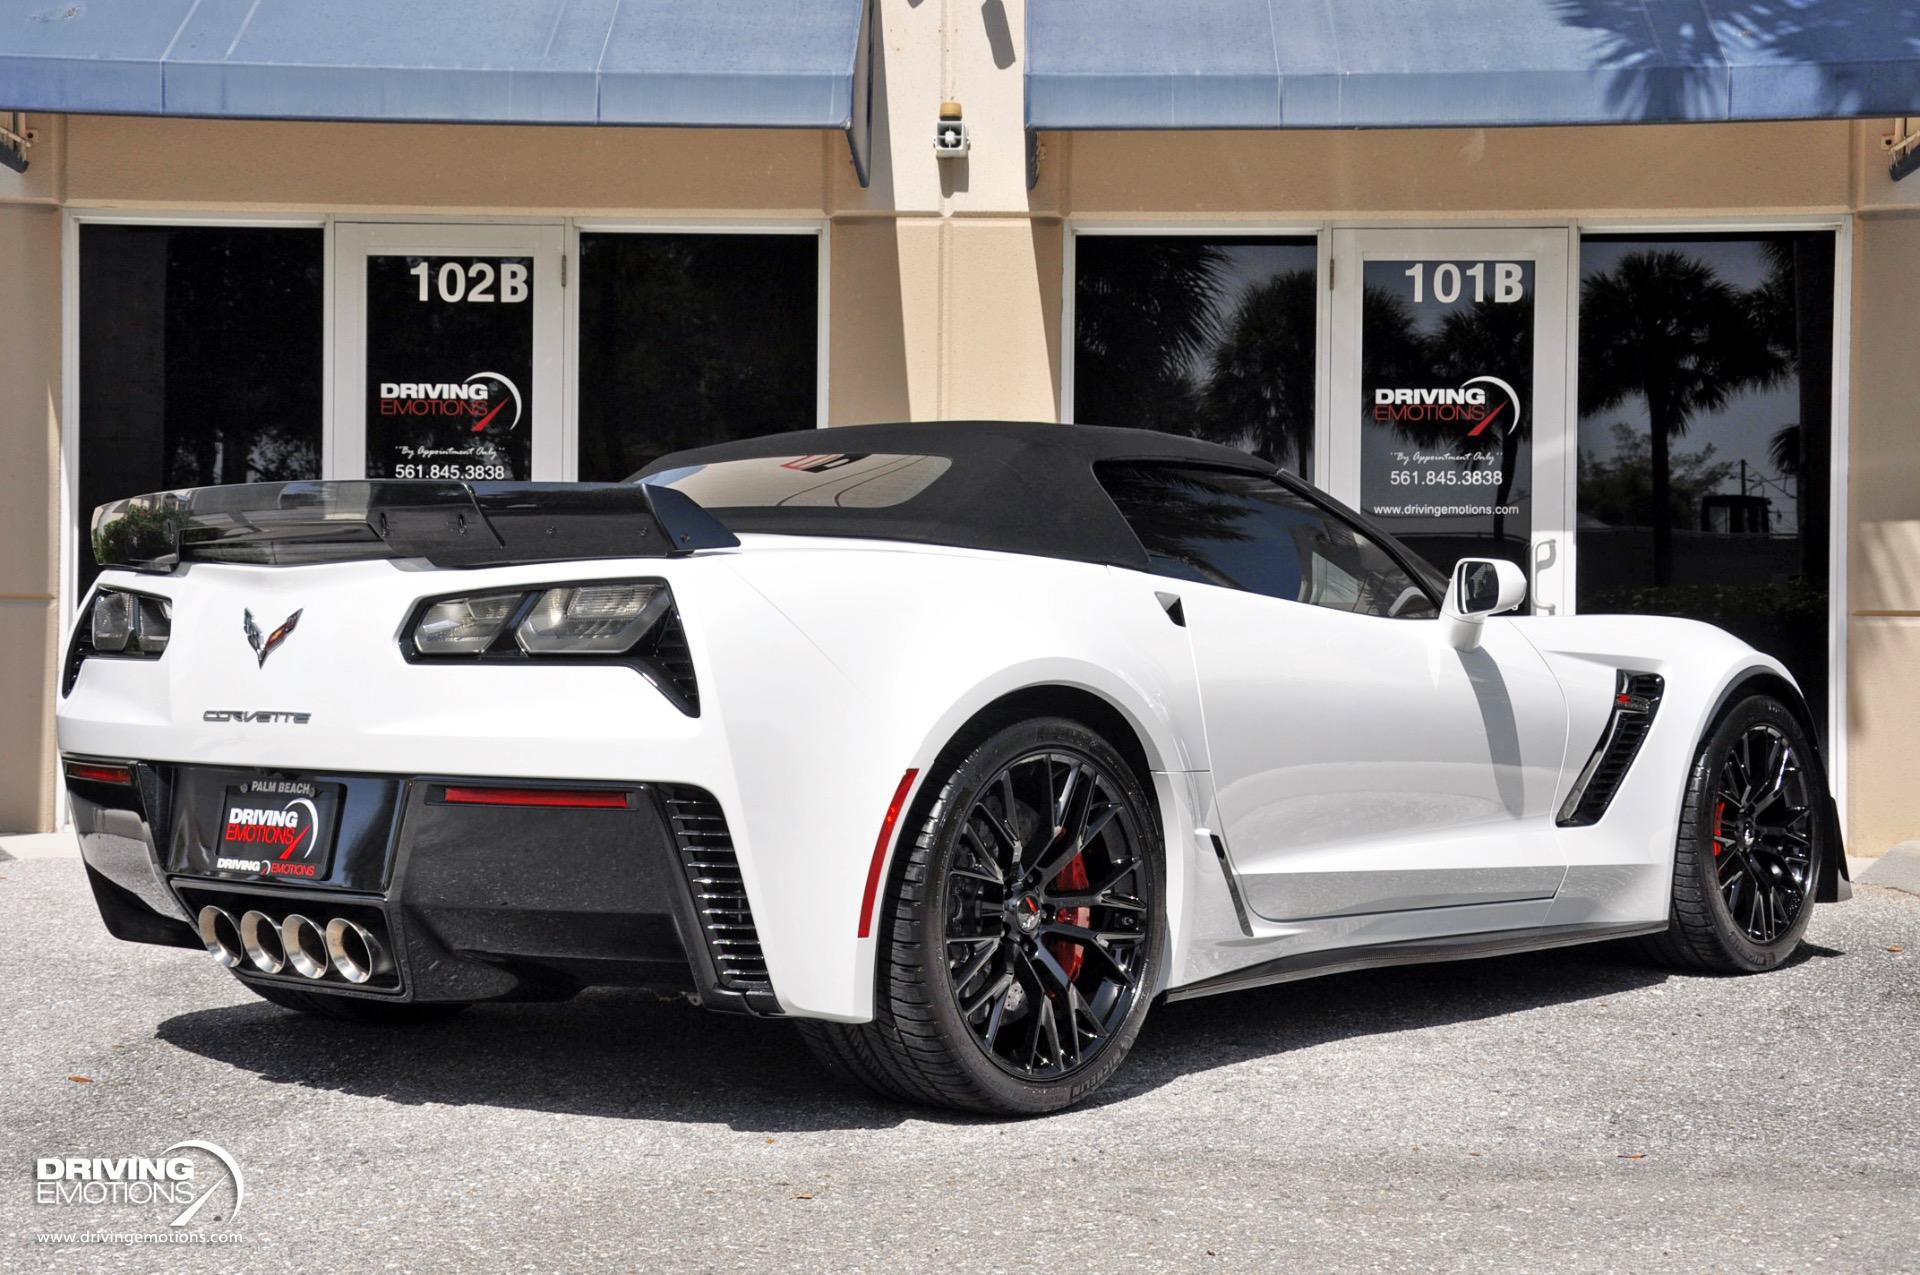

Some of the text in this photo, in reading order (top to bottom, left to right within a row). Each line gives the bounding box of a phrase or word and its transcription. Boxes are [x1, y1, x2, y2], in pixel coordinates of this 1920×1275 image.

[410, 262, 528, 303] 102B
[1405, 262, 1524, 303] 101B
[380, 383, 488, 400] DRIVING
[1375, 388, 1486, 405] DRIVING
[380, 400, 488, 416] EMOTIONS
[1375, 405, 1485, 421] EMOTIONS
[416, 446, 474, 458] Appointment
[1413, 453, 1470, 464] Appointment
[395, 464, 505, 480] 561.845.3838
[1390, 470, 1503, 485] 561.845.3838
[1374, 504, 1519, 517] www.drivingemotions.com
[203, 710, 312, 724] CORVETTE
[251, 780, 310, 795] PALM BEACH
[229, 808, 298, 828] DRIVING
[225, 823, 295, 844] EMOTIONS
[217, 858, 316, 876] DRIVING EMOTIONS
